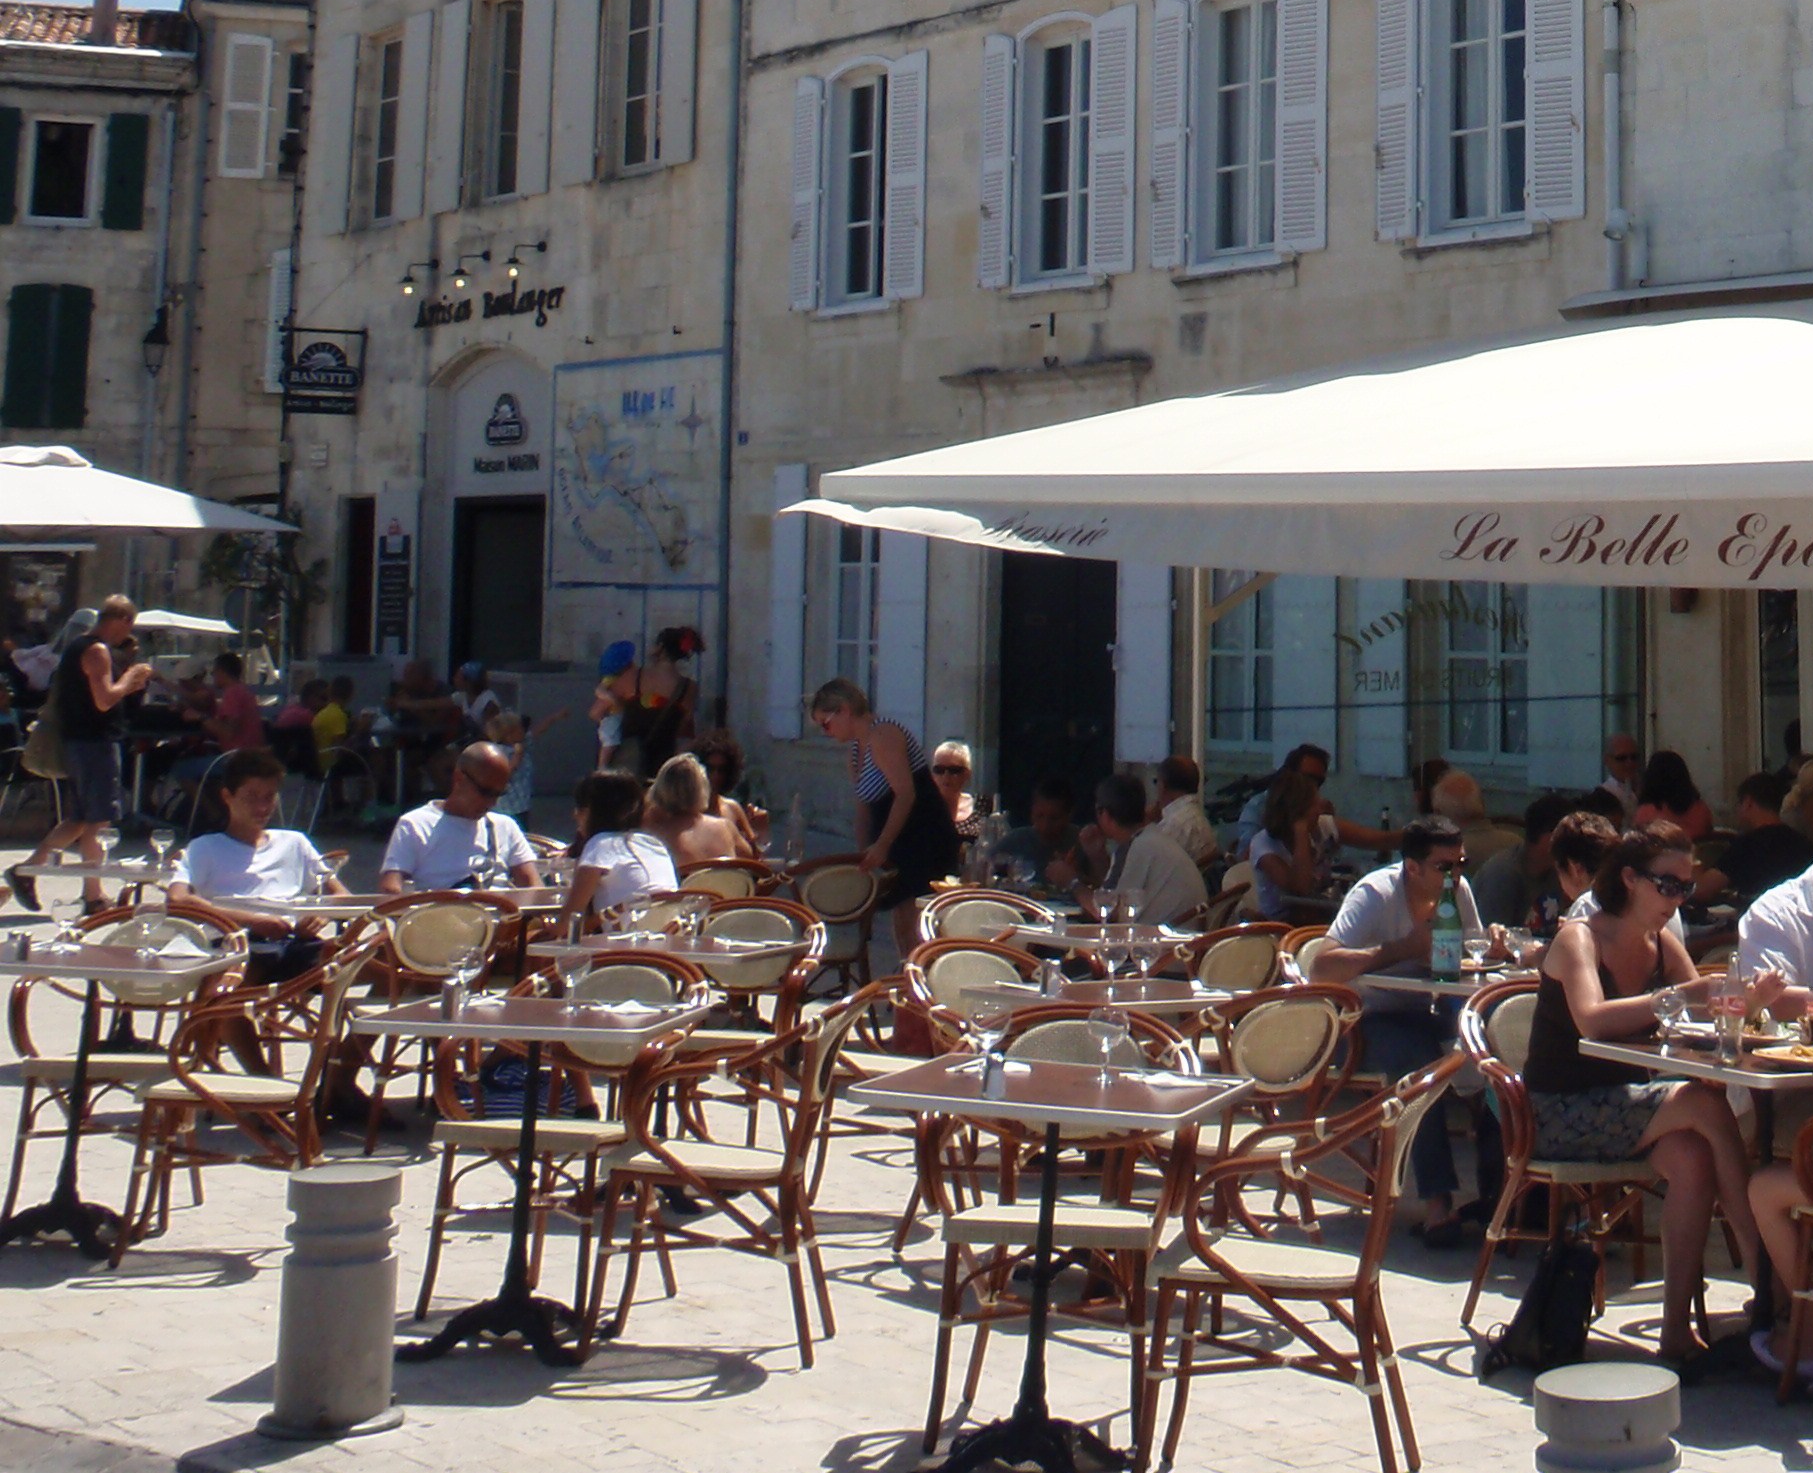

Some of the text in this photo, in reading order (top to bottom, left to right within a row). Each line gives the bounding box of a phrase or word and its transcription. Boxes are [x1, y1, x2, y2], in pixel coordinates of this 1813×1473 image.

[289, 370, 354, 385] BANETTE
[1439, 511, 1519, 564] La
[1539, 511, 1691, 567] Belle
